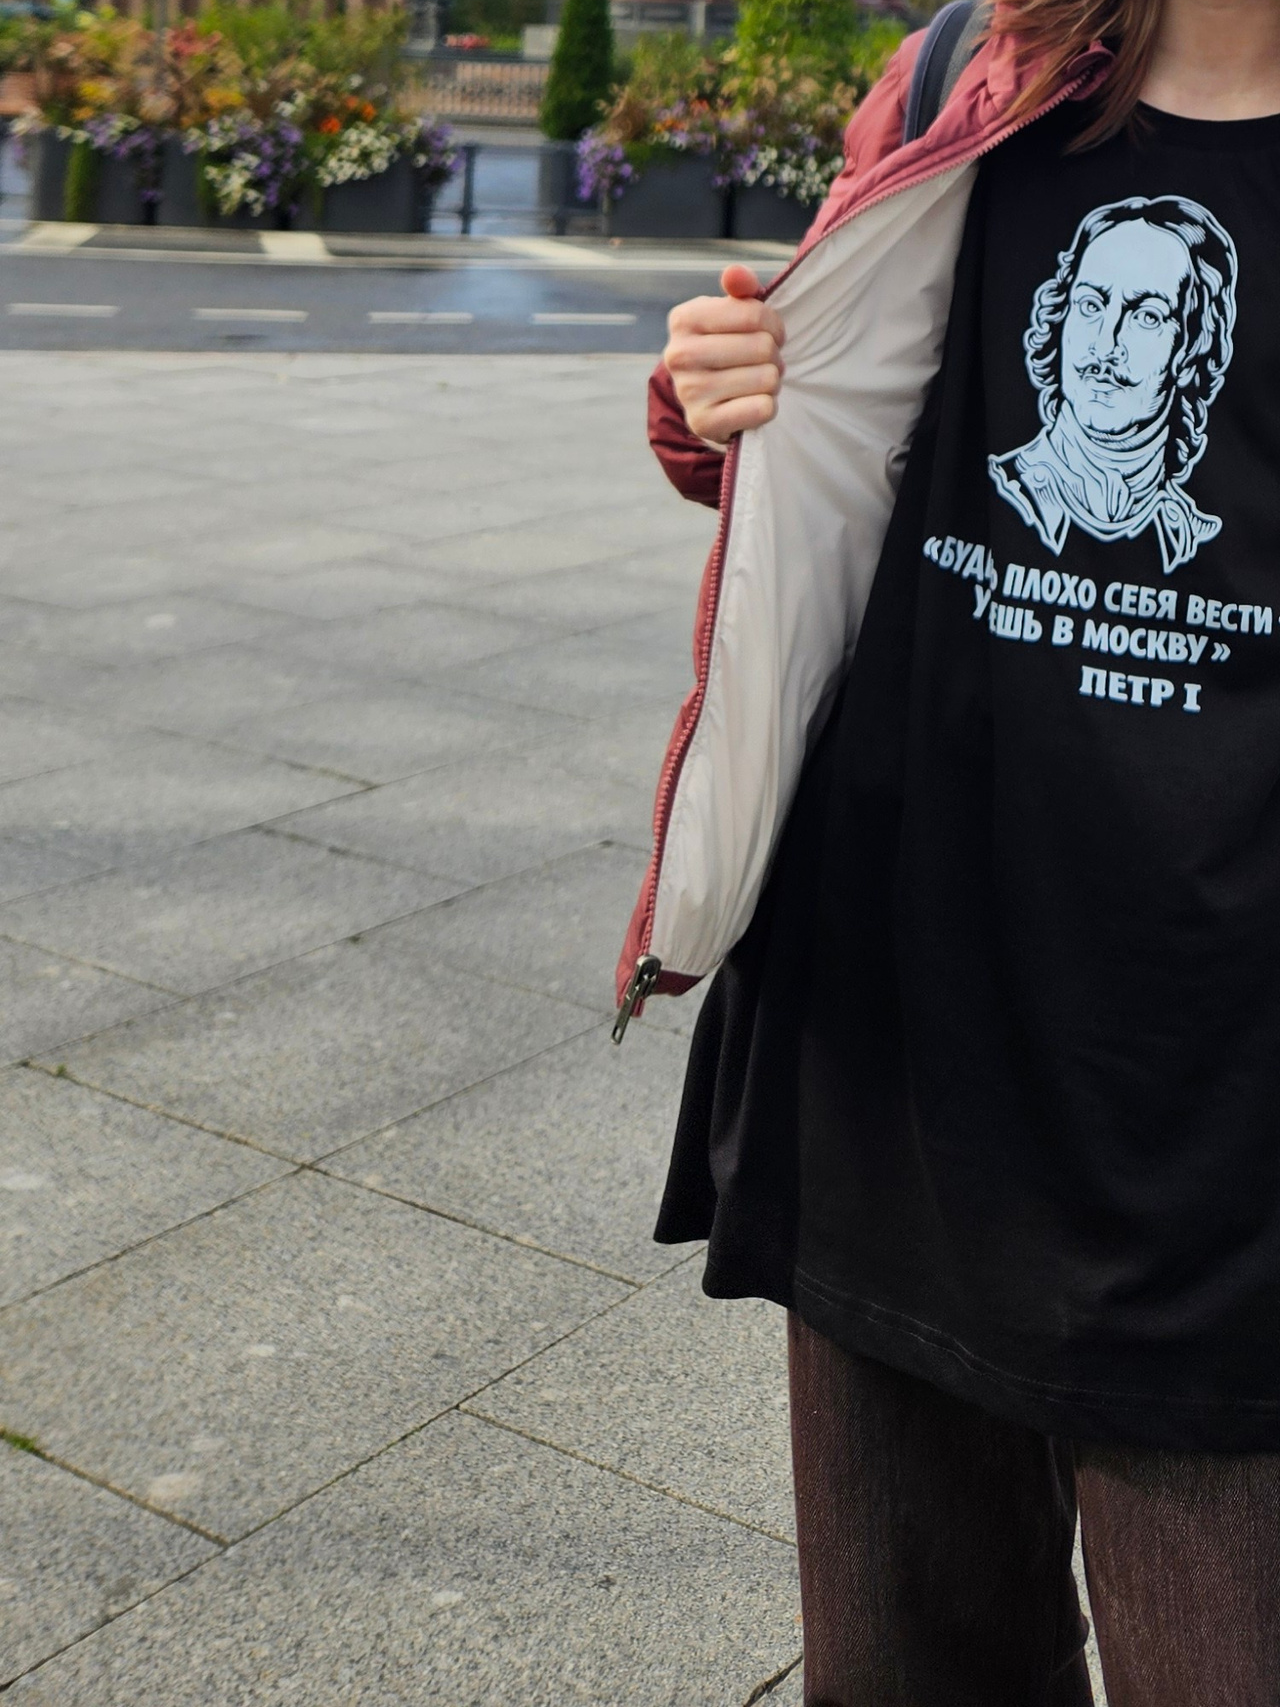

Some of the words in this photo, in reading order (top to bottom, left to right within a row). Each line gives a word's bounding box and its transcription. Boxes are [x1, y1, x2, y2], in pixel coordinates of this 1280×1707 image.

[1003, 562, 1097, 611] ПЛОХО
[1104, 581, 1178, 620] СЕБЯ
[1052, 614, 1075, 646] В
[1079, 665, 1175, 707] ПЕТР
[1183, 682, 1202, 713] I
